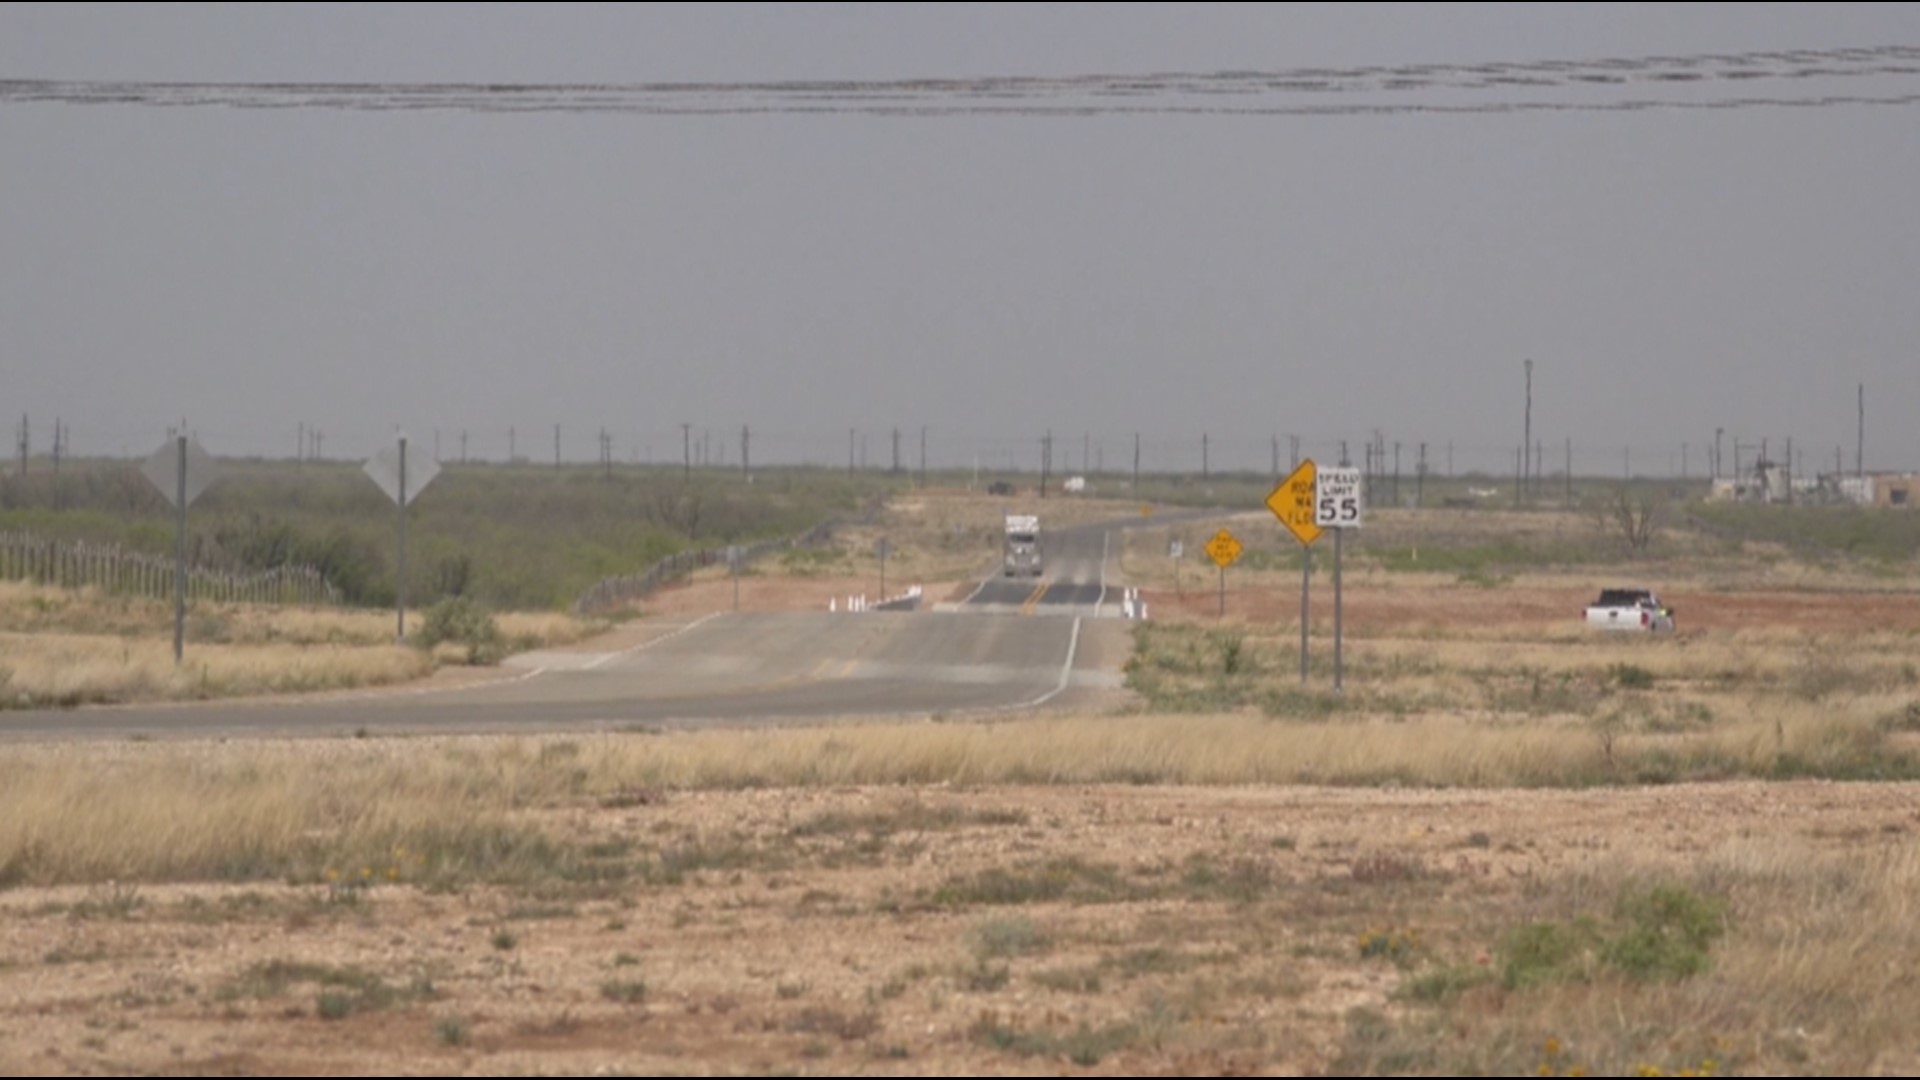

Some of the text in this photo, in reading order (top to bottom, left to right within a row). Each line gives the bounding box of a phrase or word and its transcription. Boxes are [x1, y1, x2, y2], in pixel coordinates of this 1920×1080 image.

[1291, 481, 1317, 494] ROA
[1322, 486, 1353, 496] LIMIT
[1295, 497, 1312, 507] MA
[1320, 498, 1357, 520] 55
